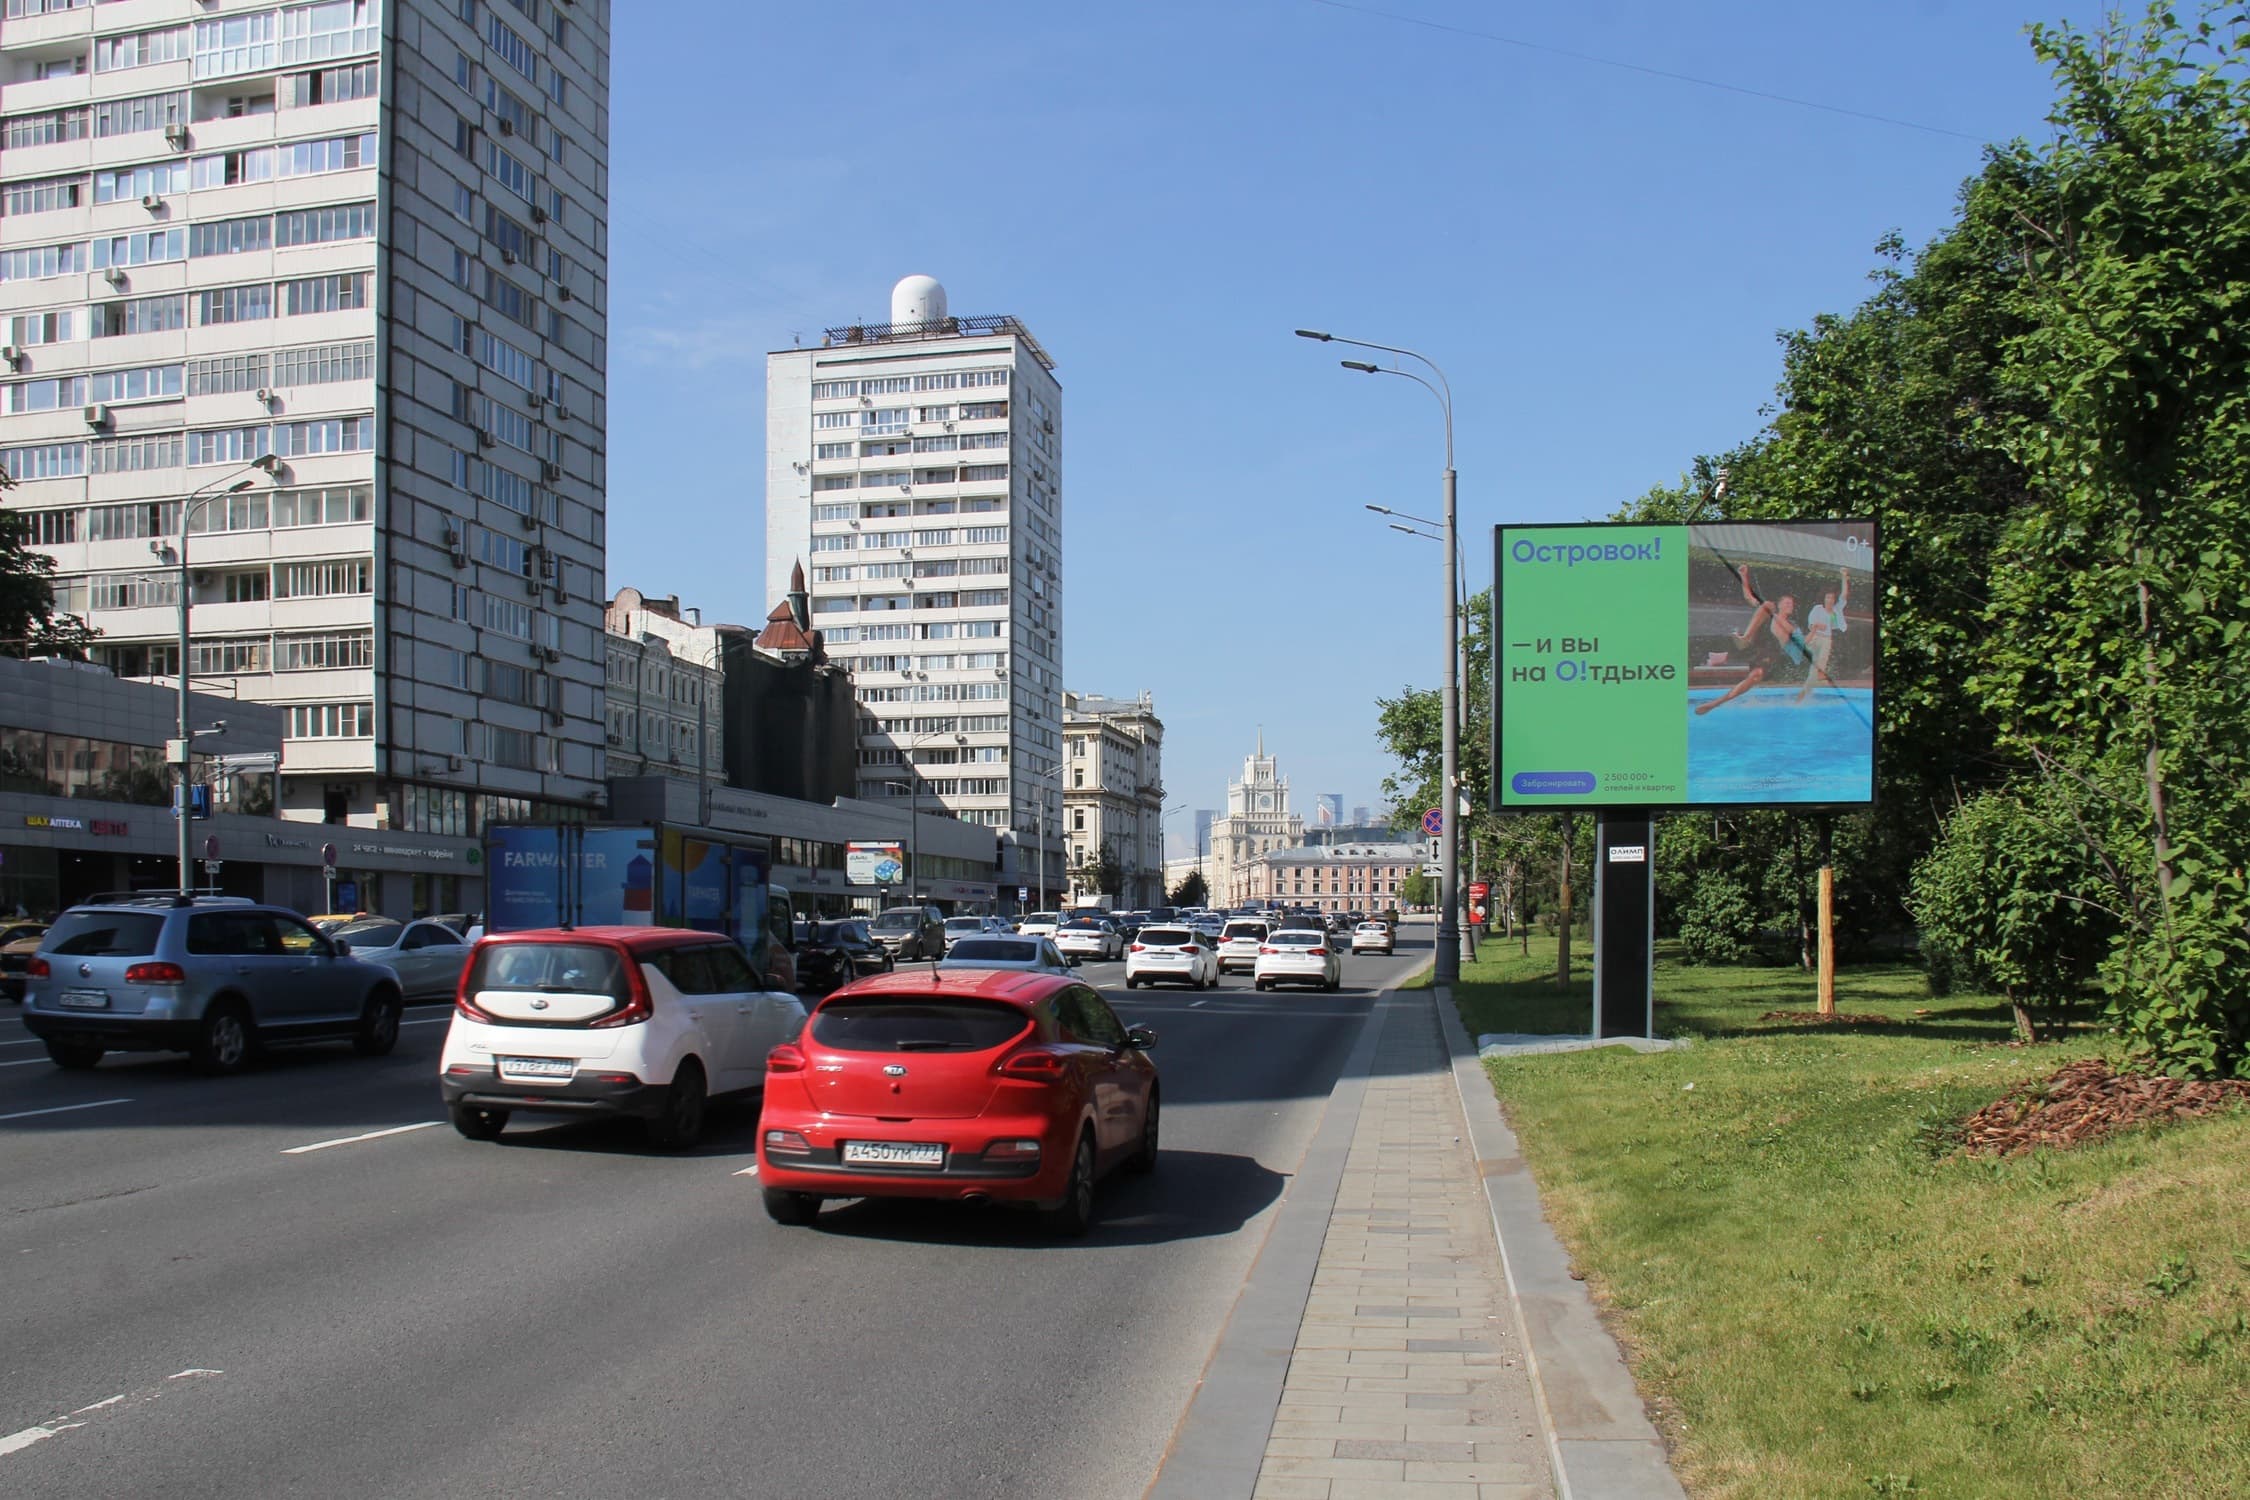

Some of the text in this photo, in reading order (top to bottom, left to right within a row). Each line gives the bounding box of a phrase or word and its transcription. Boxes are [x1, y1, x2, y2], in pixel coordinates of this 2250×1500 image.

[1846, 535, 1870, 552] 0+
[1512, 537, 1661, 567] Островок!
[1561, 637, 1599, 653] вы
[1512, 660, 1676, 685] на О!тдыхе
[1520, 778, 1587, 790] Забронировать
[1604, 784, 1633, 792] отелей
[1642, 784, 1676, 793] квартир
[50, 818, 82, 829] АПТЕКА
[1610, 848, 1643, 856] ОЛИМП
